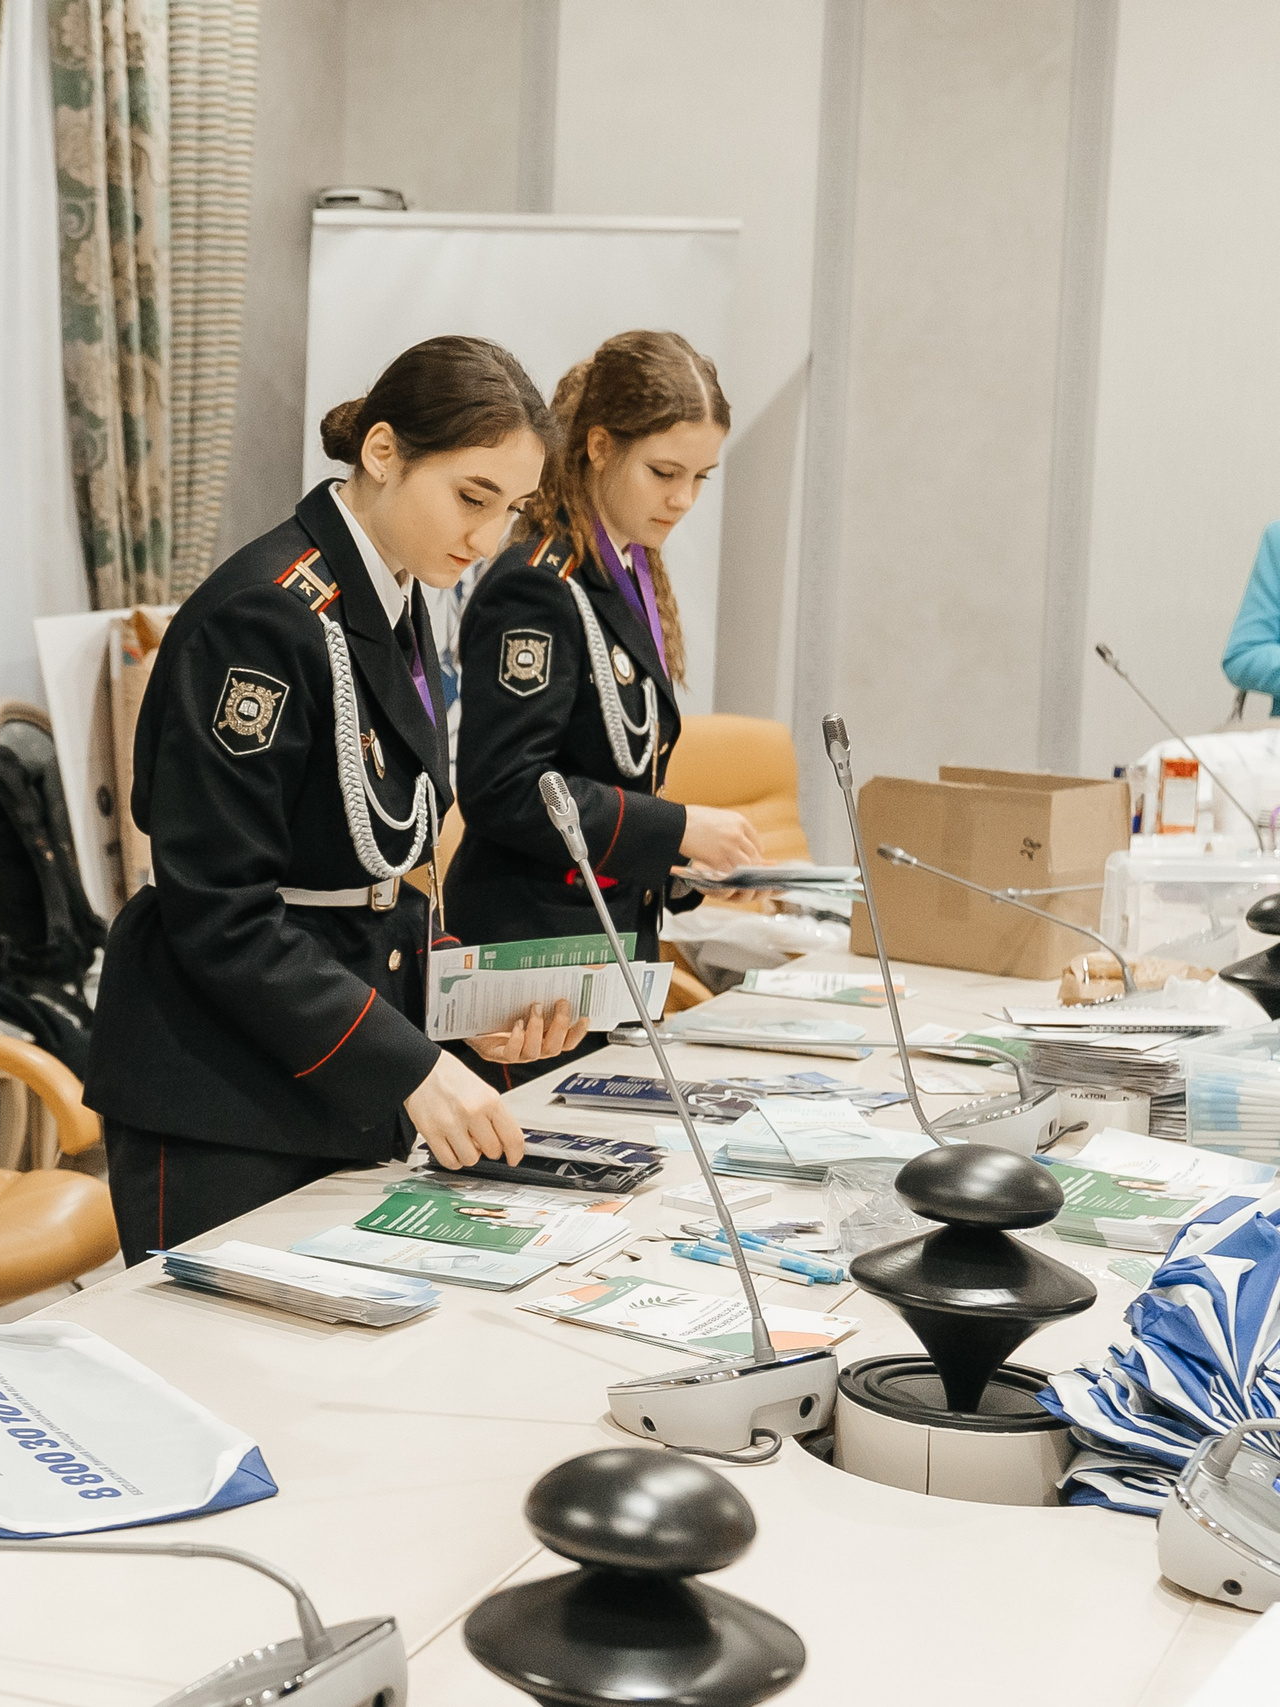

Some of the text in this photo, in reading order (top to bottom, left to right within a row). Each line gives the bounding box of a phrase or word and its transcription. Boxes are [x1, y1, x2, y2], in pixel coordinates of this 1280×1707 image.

[297, 578, 315, 597] К
[6, 1428, 60, 1450] 30
[34, 1451, 104, 1485] 800
[78, 1486, 122, 1500] 8
